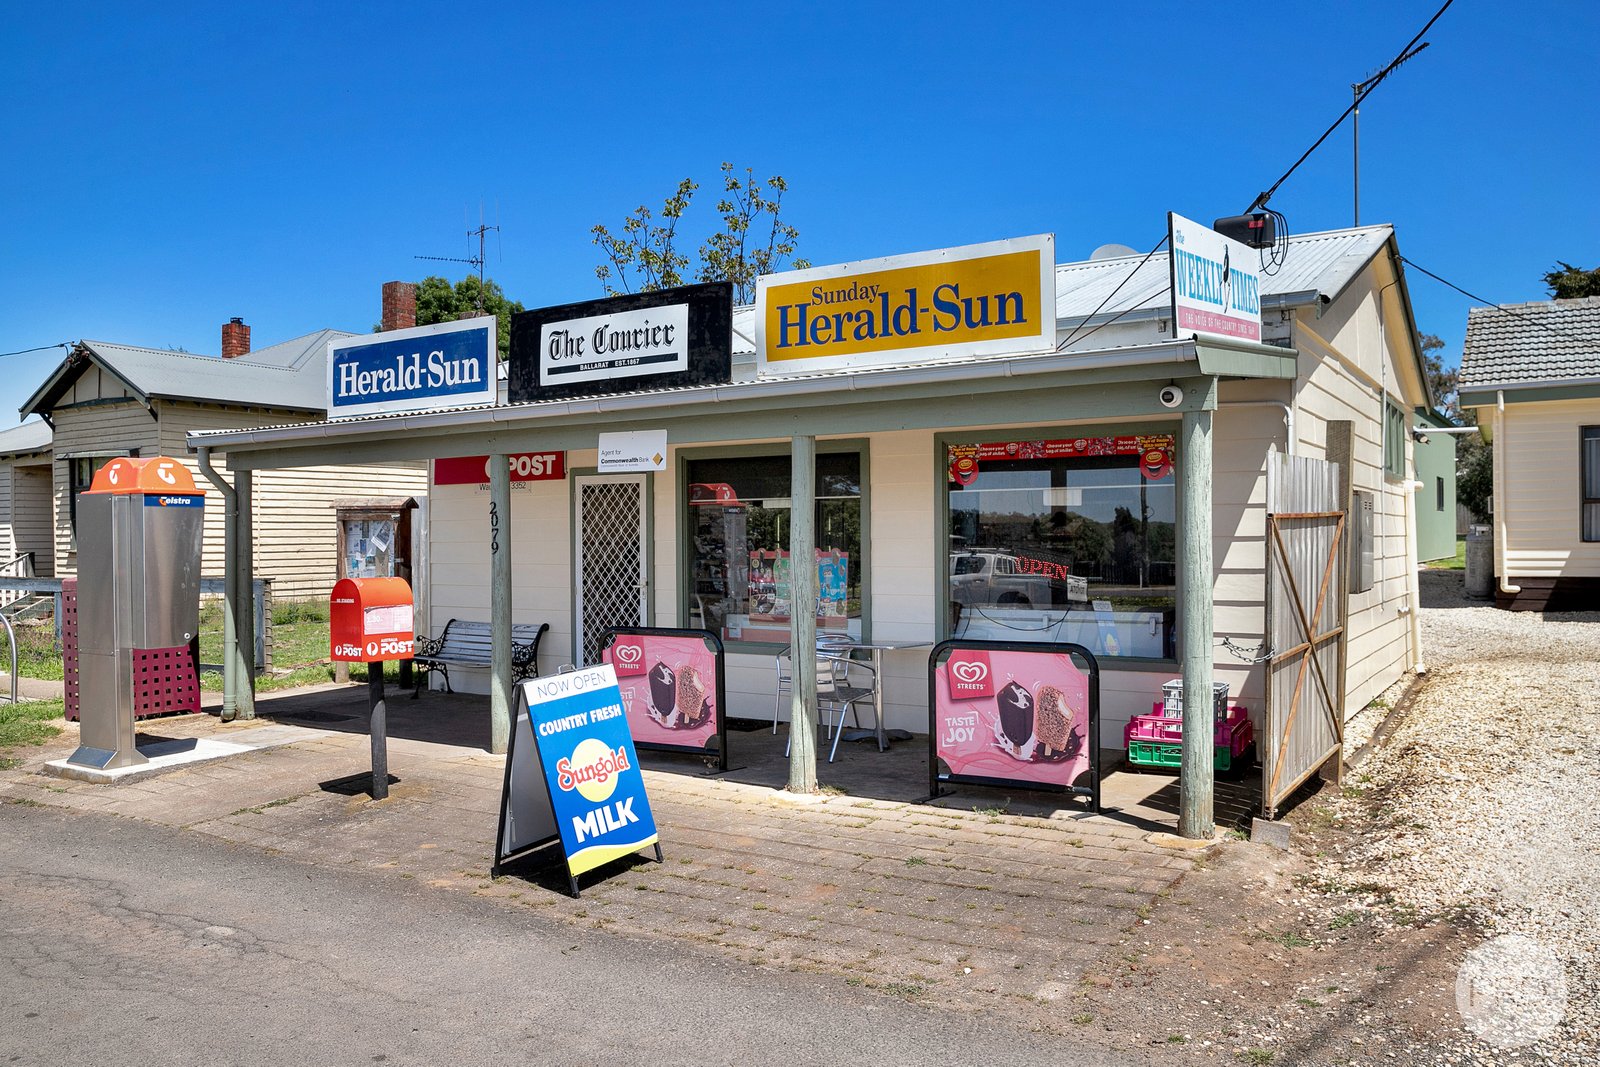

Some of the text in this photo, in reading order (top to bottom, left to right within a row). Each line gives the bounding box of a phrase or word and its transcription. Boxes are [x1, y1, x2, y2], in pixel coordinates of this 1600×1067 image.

[810, 280, 881, 307] Sunday
[1175, 248, 1259, 316] WEEKLY TIMES
[775, 283, 1028, 349] Herald-Sun
[548, 319, 675, 361] The Courier
[338, 350, 481, 397] Herald-Sun
[579, 361, 609, 371] BALLARAT
[509, 454, 556, 477] POST
[510, 481, 527, 490] 3352
[158, 496, 191, 507] Telstra
[489, 501, 499, 555] 2079
[1013, 556, 1069, 581] OPEN
[342, 647, 362, 656] POST
[380, 641, 414, 654] POST
[537, 671, 607, 699] NOW OPEN
[539, 704, 623, 737] COUNTRY FRESH
[944, 716, 975, 727] TASTE
[945, 727, 975, 743] JOY
[557, 746, 630, 790] Sungold
[572, 797, 639, 843] MILK
